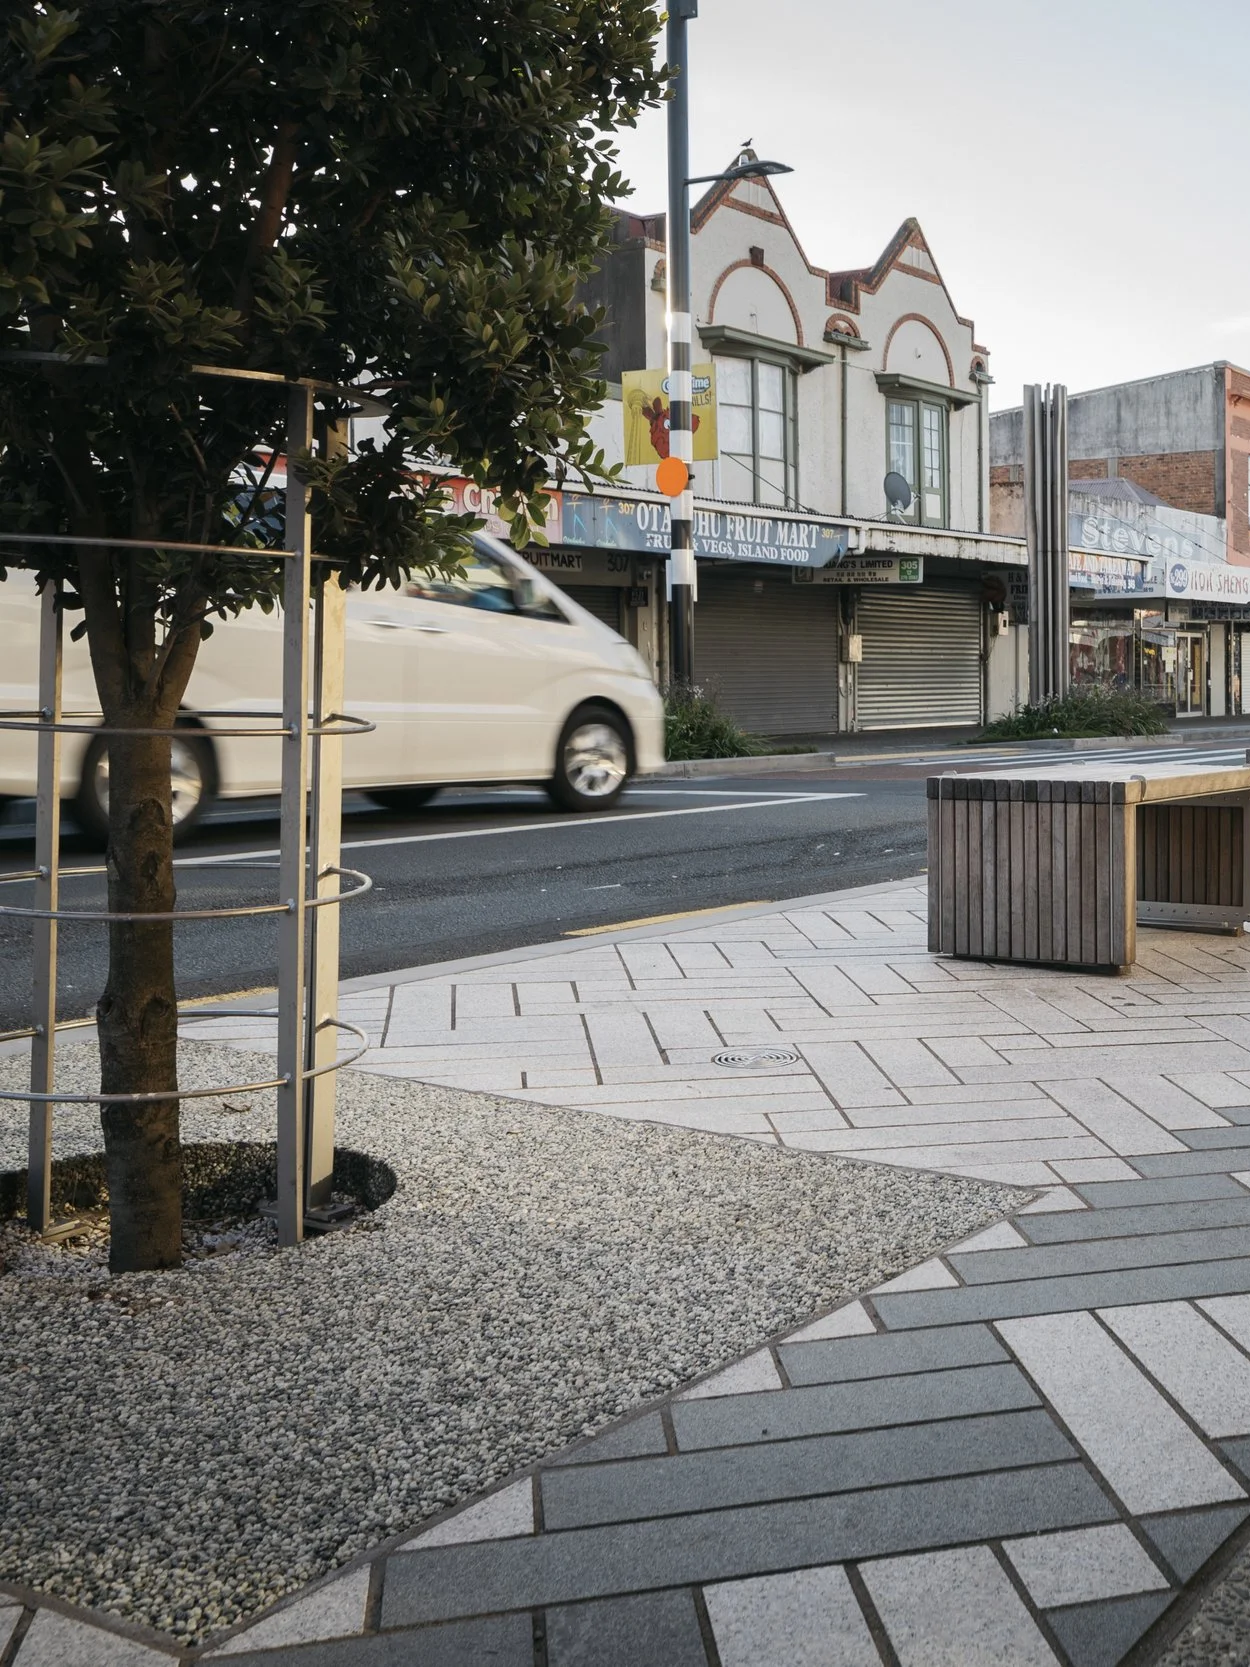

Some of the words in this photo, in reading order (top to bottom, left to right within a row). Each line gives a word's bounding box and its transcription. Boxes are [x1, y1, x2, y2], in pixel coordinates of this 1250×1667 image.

[618, 503, 635, 514] 307
[725, 514, 772, 543] FRUIT
[774, 521, 819, 548] MART
[1081, 516, 1194, 558] Stevens
[607, 552, 629, 572] 307
[646, 533, 671, 549] FRU
[701, 540, 735, 557] VEGS,
[737, 543, 777, 560] ISLAND
[780, 548, 809, 562] FOOD
[860, 560, 893, 569] LIMITED
[901, 561, 917, 570] 305
